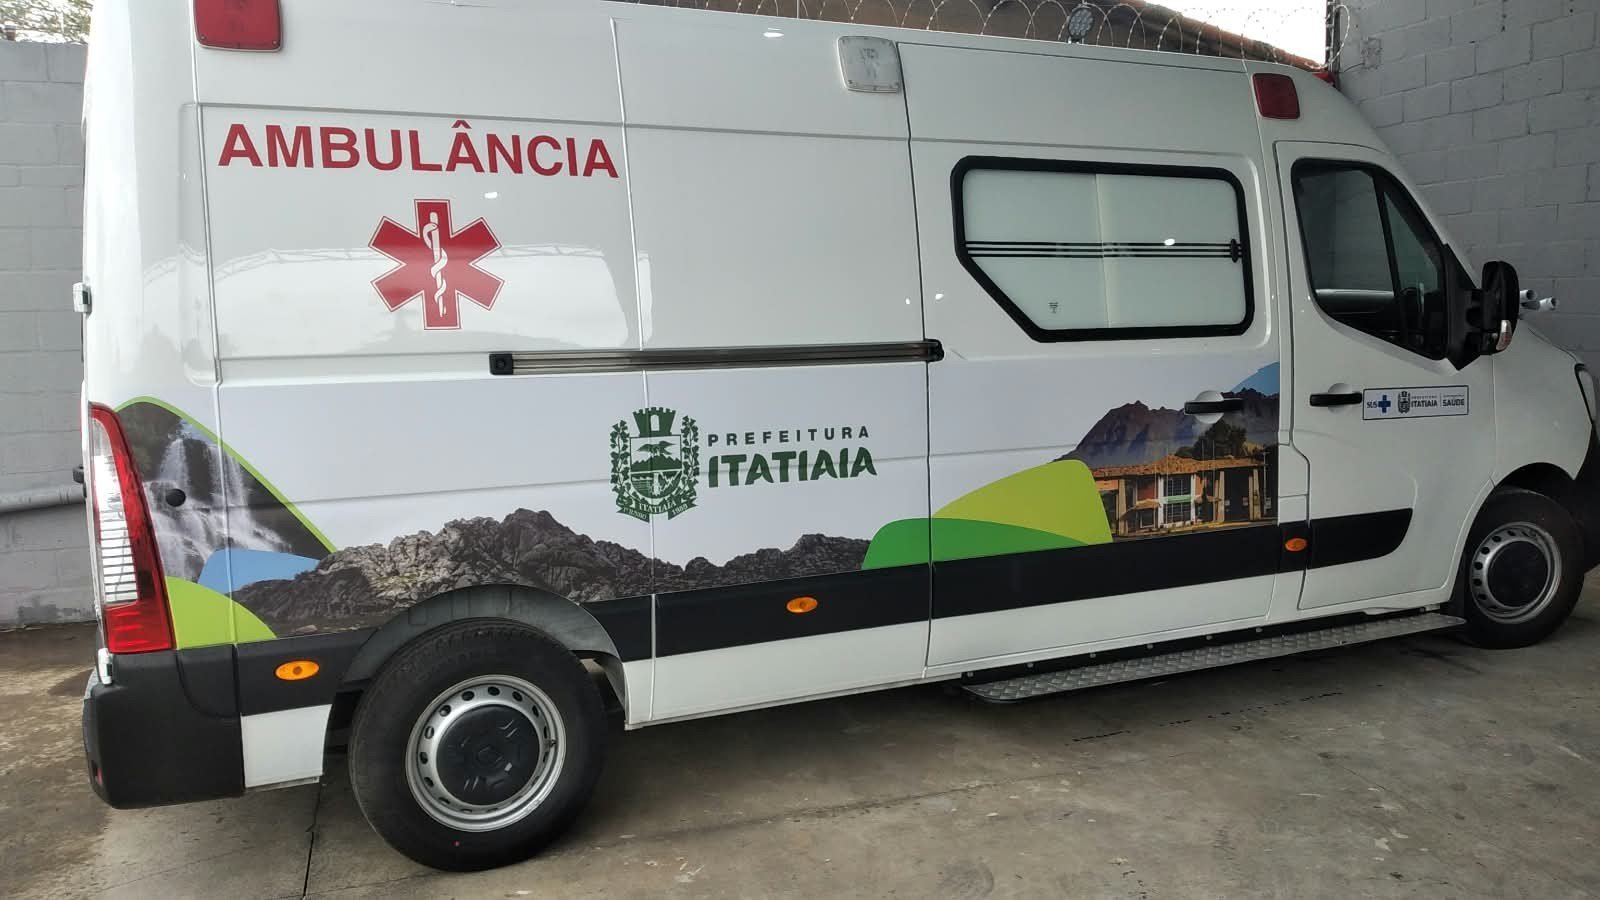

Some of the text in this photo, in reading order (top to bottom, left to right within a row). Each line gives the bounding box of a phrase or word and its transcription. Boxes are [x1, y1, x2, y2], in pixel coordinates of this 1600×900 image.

[218, 120, 619, 178] AMBULÂNCIA
[1411, 399, 1438, 408] ITATIAIA
[708, 426, 869, 447] PREFEITURA
[708, 447, 877, 488] ITATIAIA
[639, 500, 677, 513] ITATIAIA
